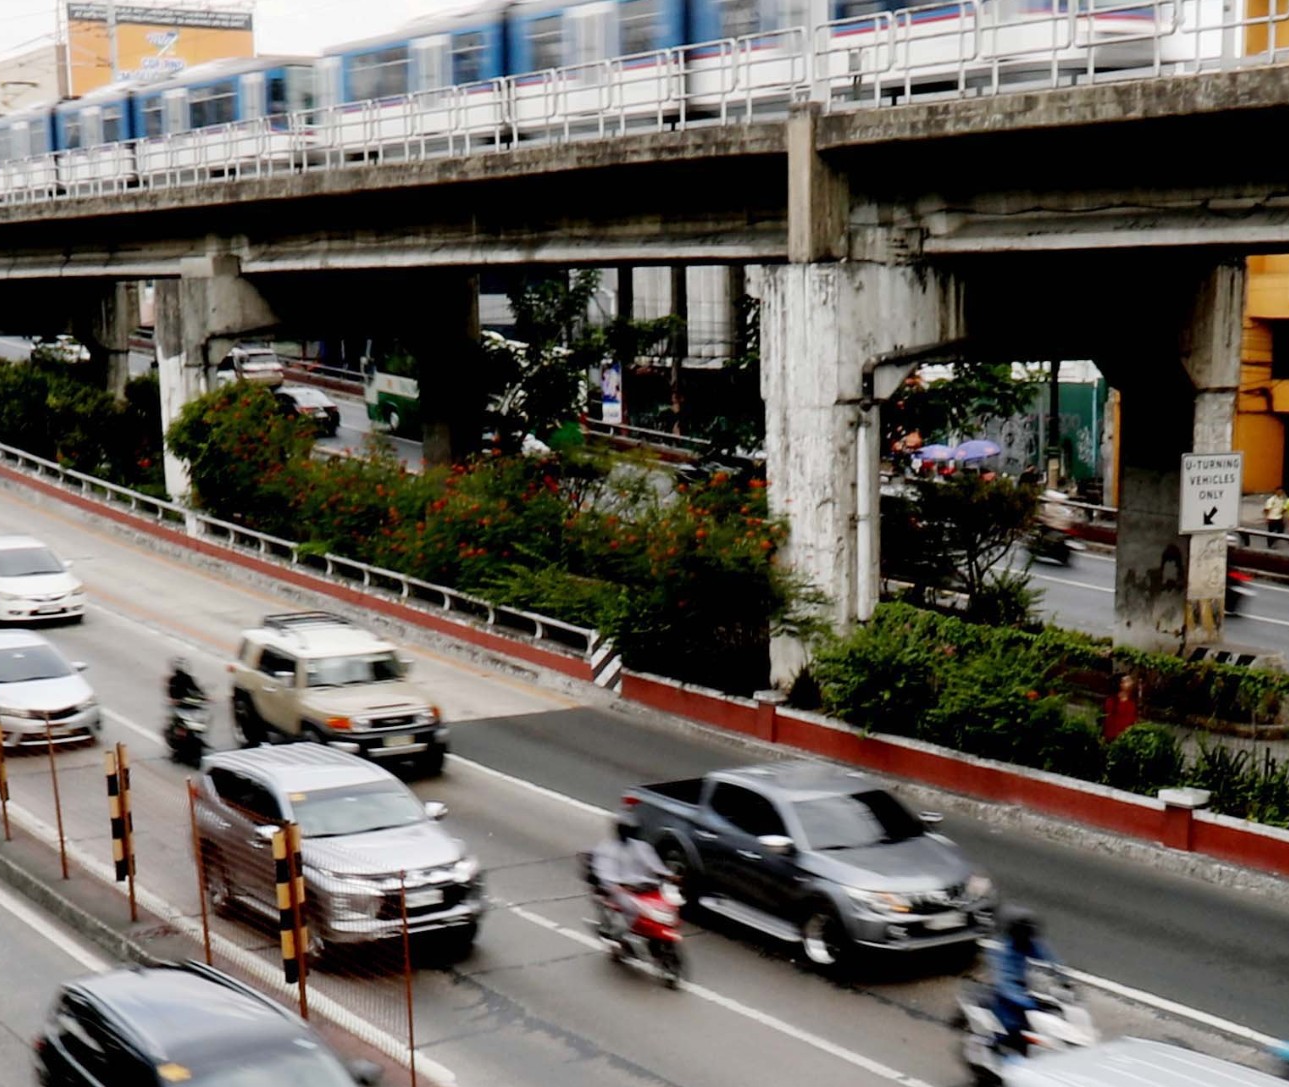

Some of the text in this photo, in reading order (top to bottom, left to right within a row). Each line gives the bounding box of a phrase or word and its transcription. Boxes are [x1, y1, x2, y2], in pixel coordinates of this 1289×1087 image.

[1185, 459, 1239, 470] U-TURNING
[1190, 473, 1235, 485] VEHICLES
[1198, 490, 1225, 500] ONLY
